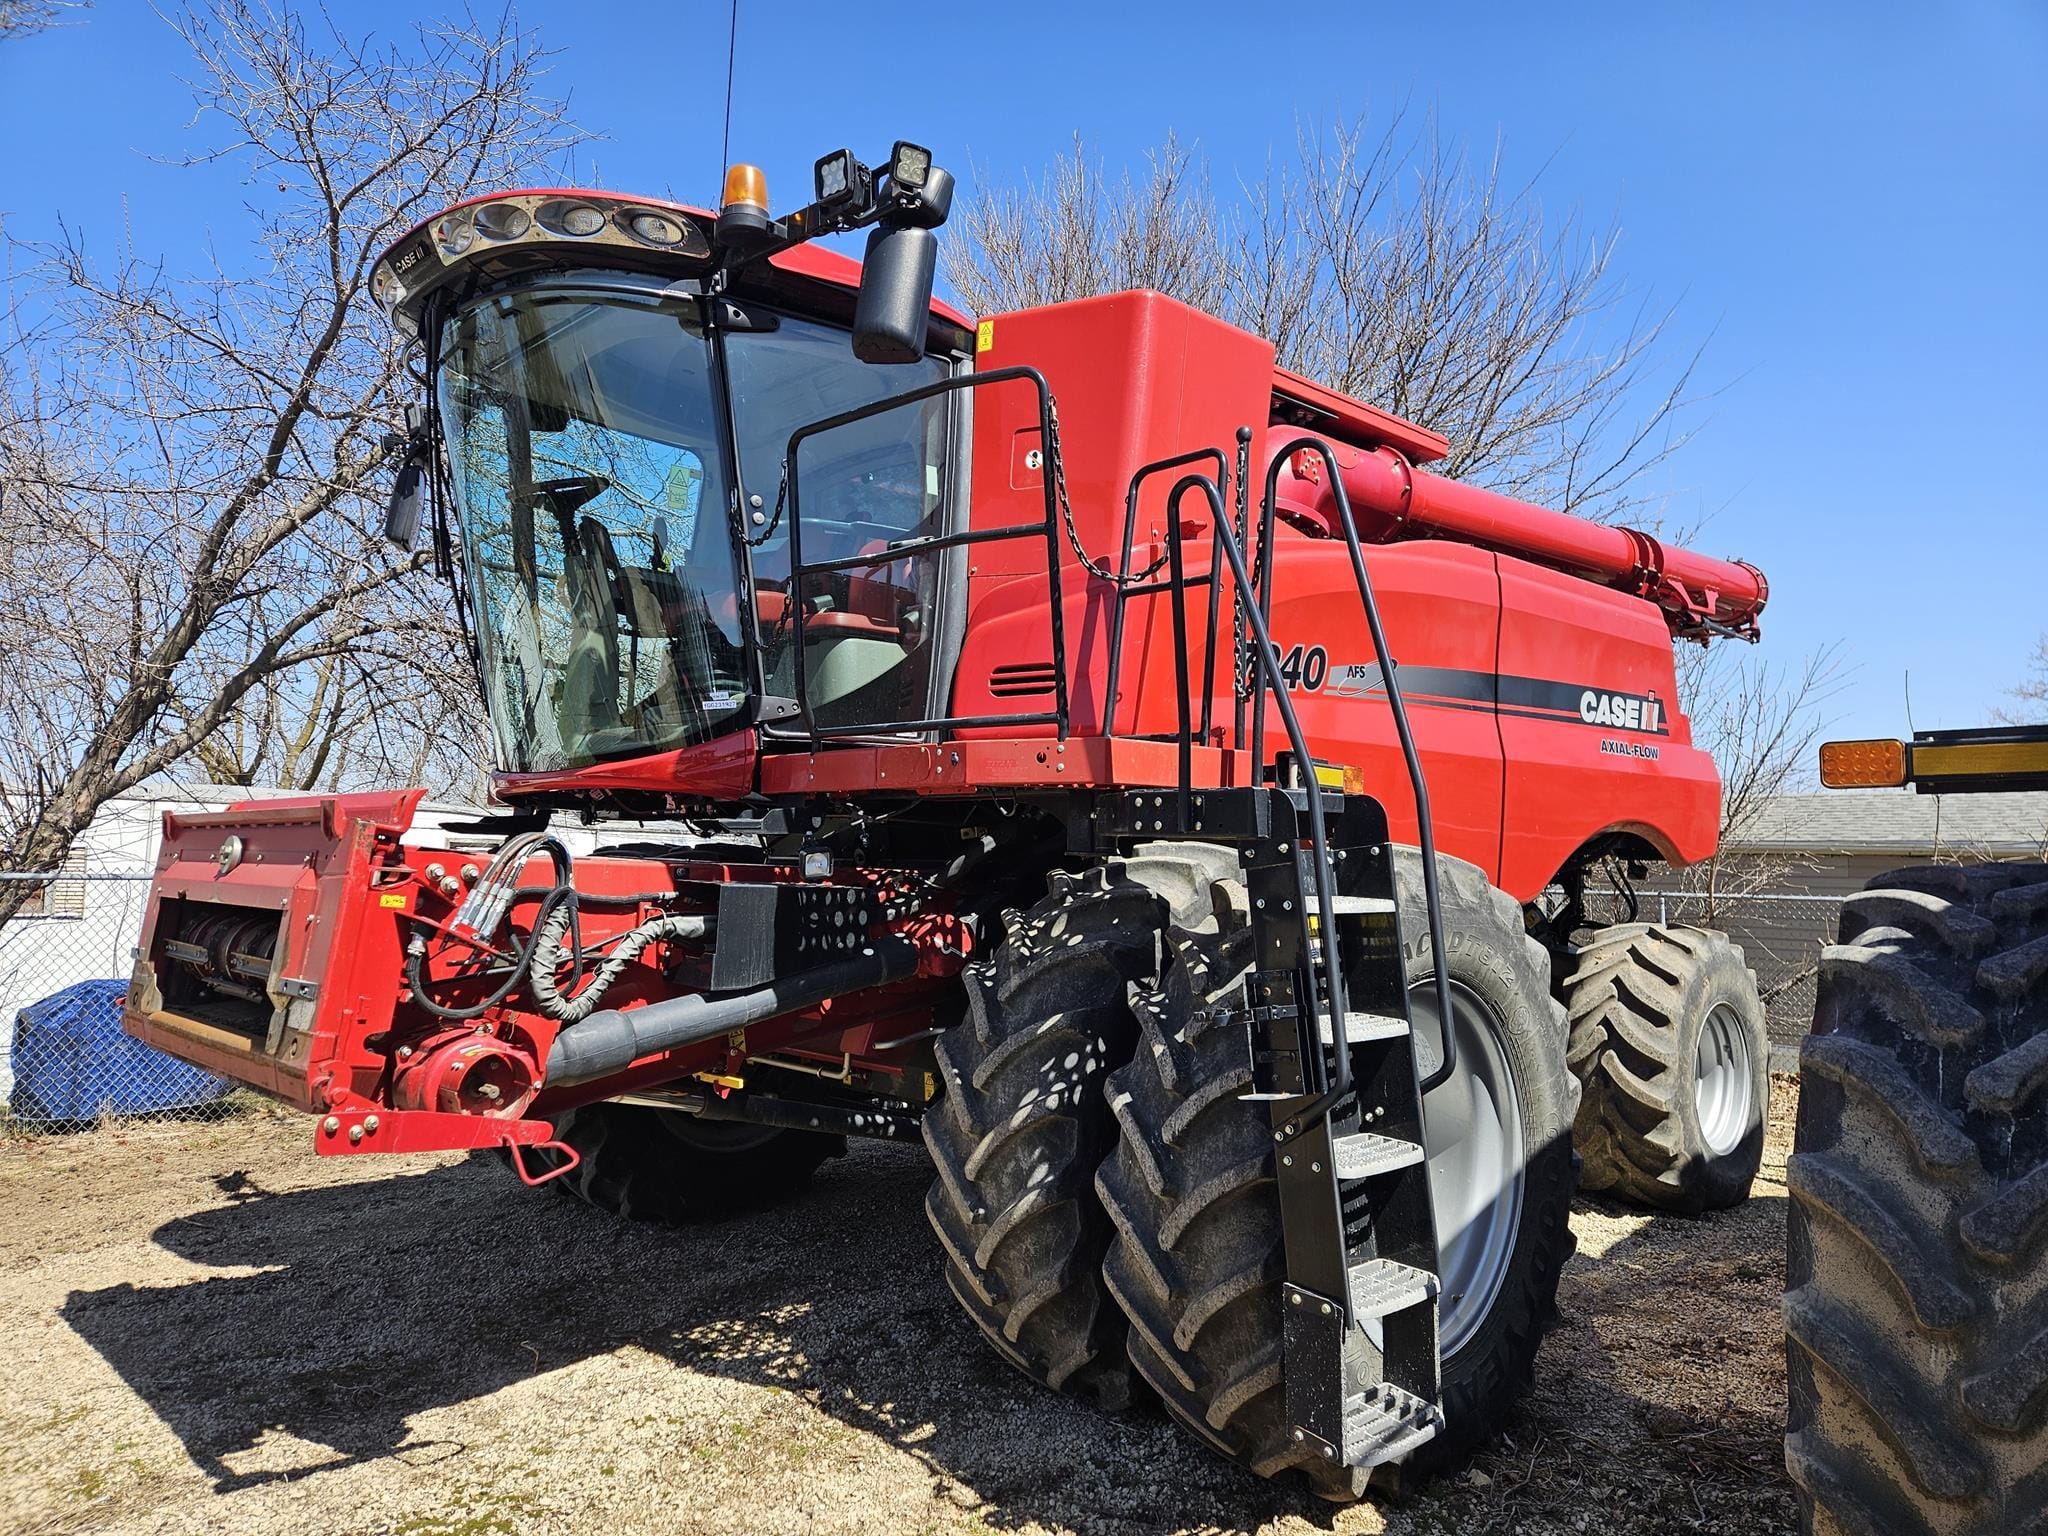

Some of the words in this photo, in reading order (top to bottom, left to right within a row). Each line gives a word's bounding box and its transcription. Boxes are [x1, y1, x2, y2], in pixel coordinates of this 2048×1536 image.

[395, 252, 417, 273] CASE
[1346, 665, 1366, 679] AFS
[1580, 690, 1640, 729] CASE
[1600, 740, 1659, 759] AXIAL-FLOW
